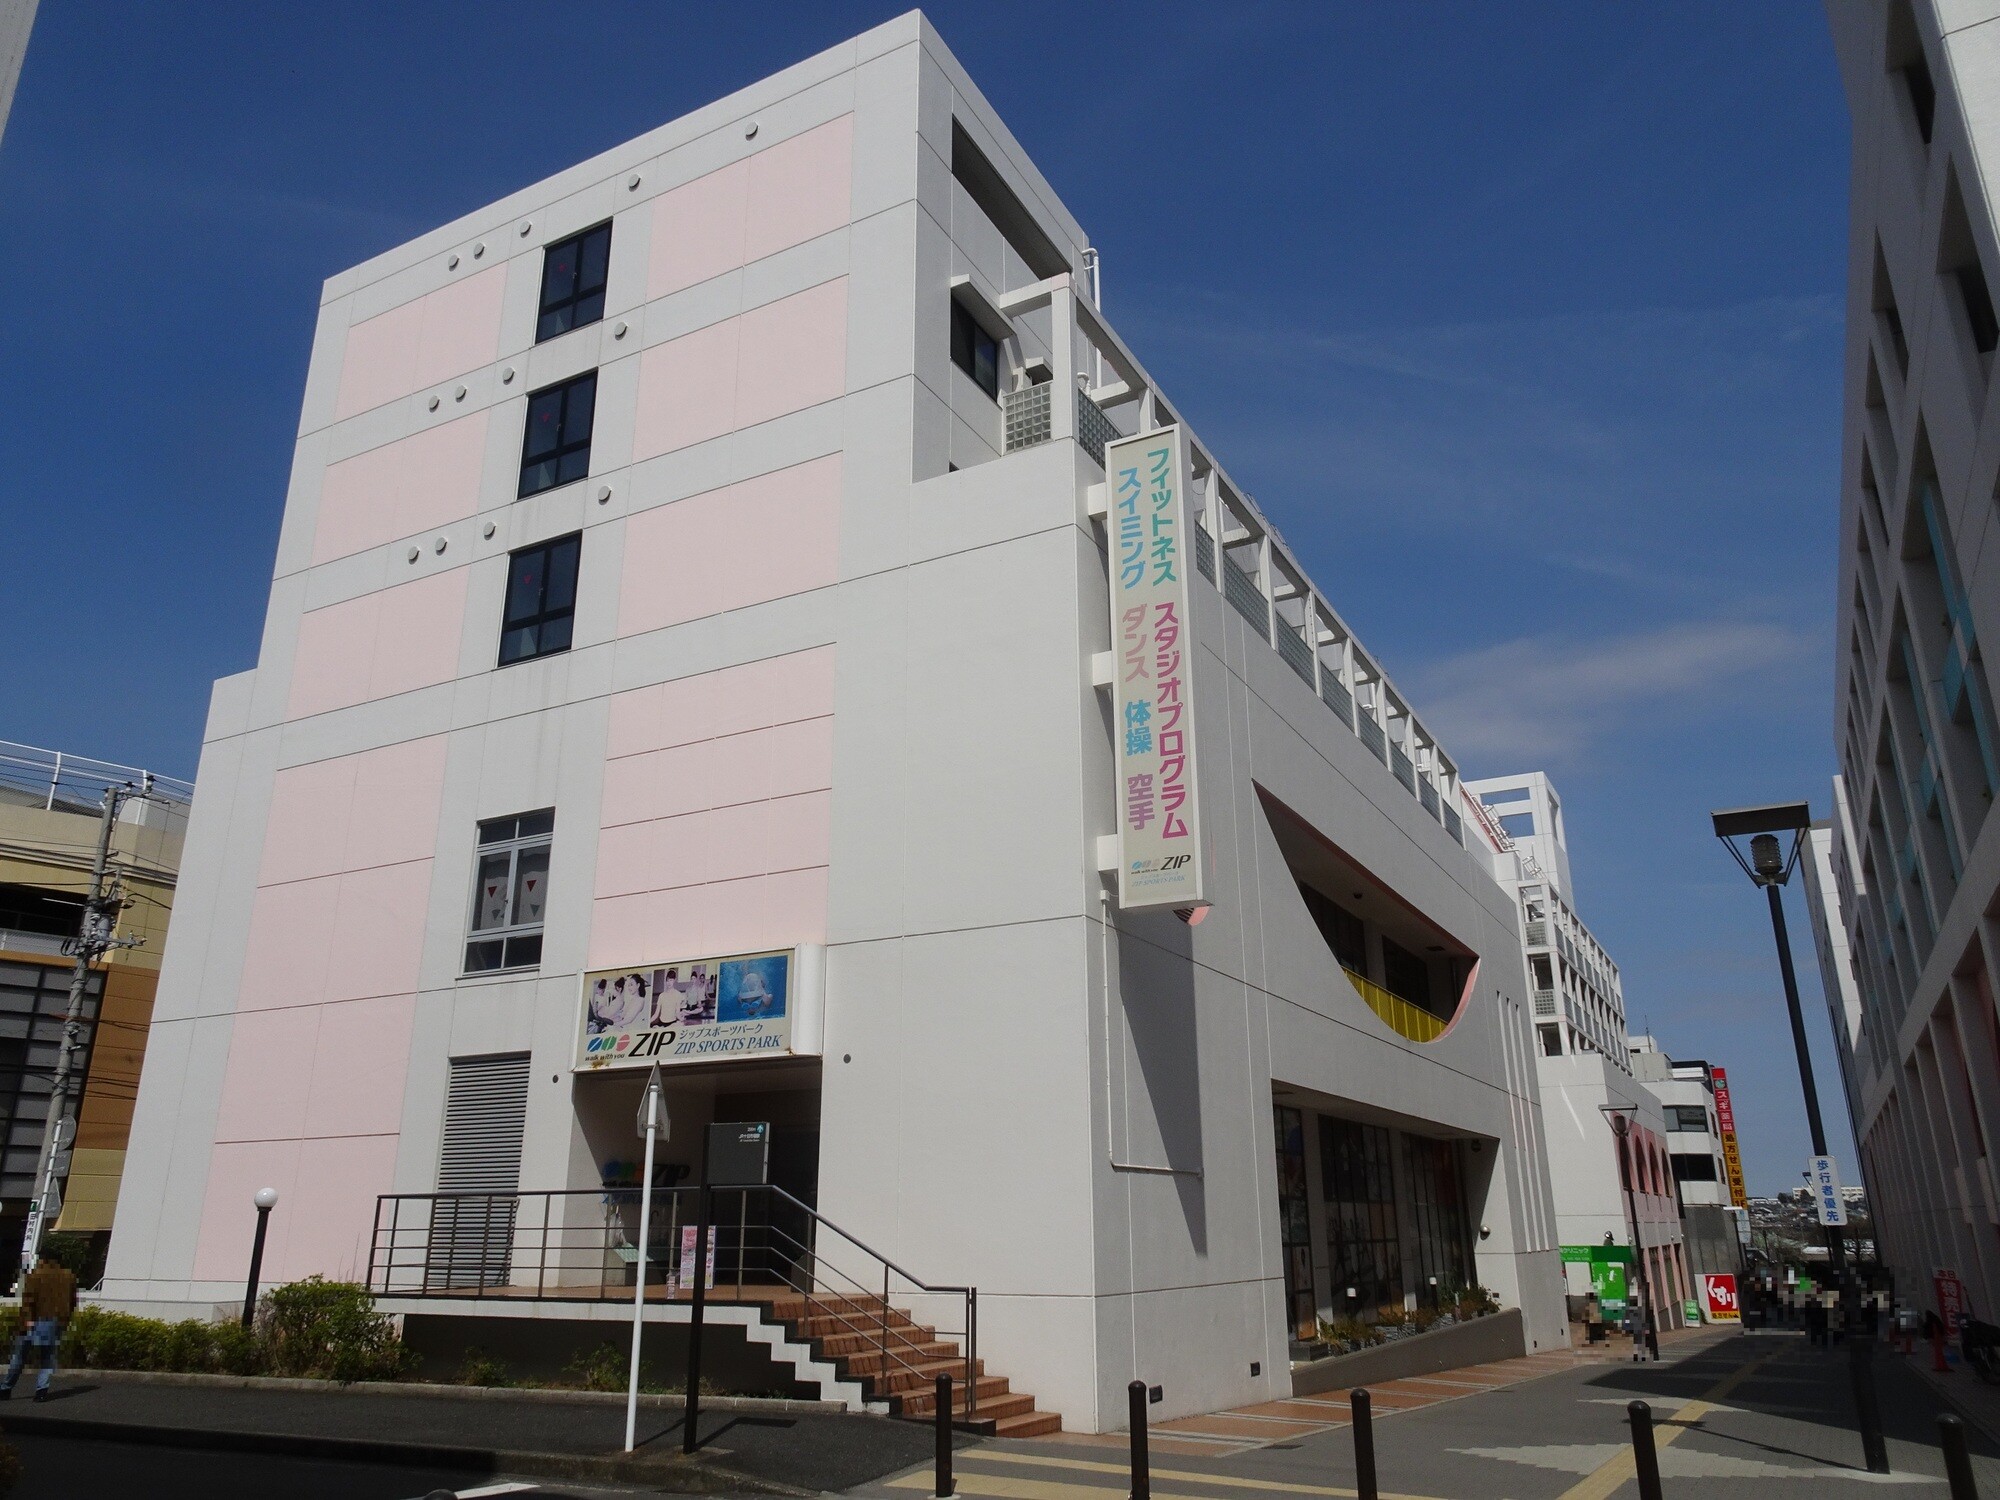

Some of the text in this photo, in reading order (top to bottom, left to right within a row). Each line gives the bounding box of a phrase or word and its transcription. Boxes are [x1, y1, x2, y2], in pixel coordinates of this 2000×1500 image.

[1118, 467, 1146, 589] スイミング
[1147, 448, 1176, 587] フィットネス
[1122, 603, 1150, 682] ダンス
[1125, 699, 1153, 756] 体操
[1154, 602, 1188, 839] スタジオプログラム
[1127, 773, 1155, 830] 空手
[1160, 854, 1191, 871] ZIP
[628, 1030, 676, 1057] ZIP
[674, 1034, 783, 1055] ZIP SPORTS PARK
[679, 1023, 764, 1040] ジップスポーツパーク
[1717, 1091, 1732, 1130] スギ薬局
[1817, 1159, 1839, 1222] 歩行者優先
[1708, 1277, 1737, 1309] くすり
